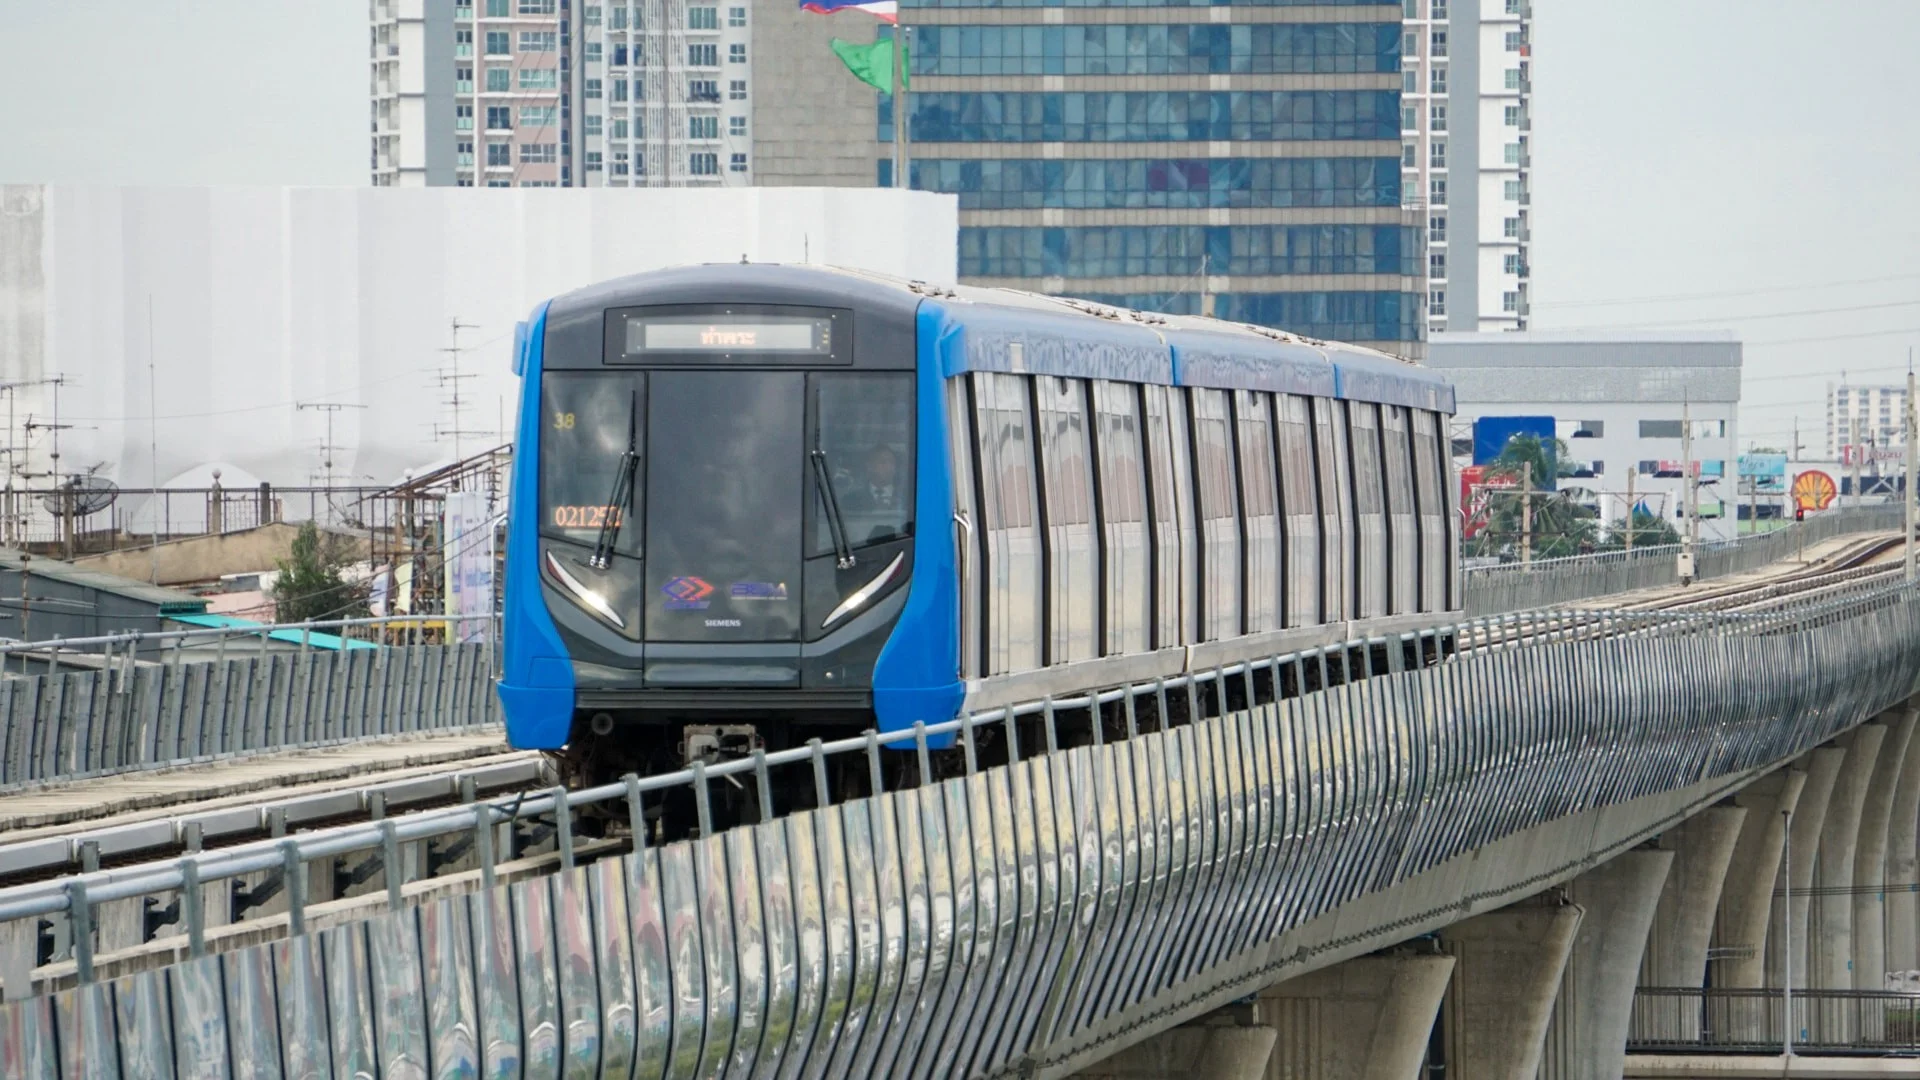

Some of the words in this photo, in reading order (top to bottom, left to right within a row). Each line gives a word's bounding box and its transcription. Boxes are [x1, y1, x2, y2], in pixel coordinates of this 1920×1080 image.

[553, 413, 575, 429] 38
[1868, 451, 1903, 460] IUZU
[704, 620, 742, 628] SIEMENS
